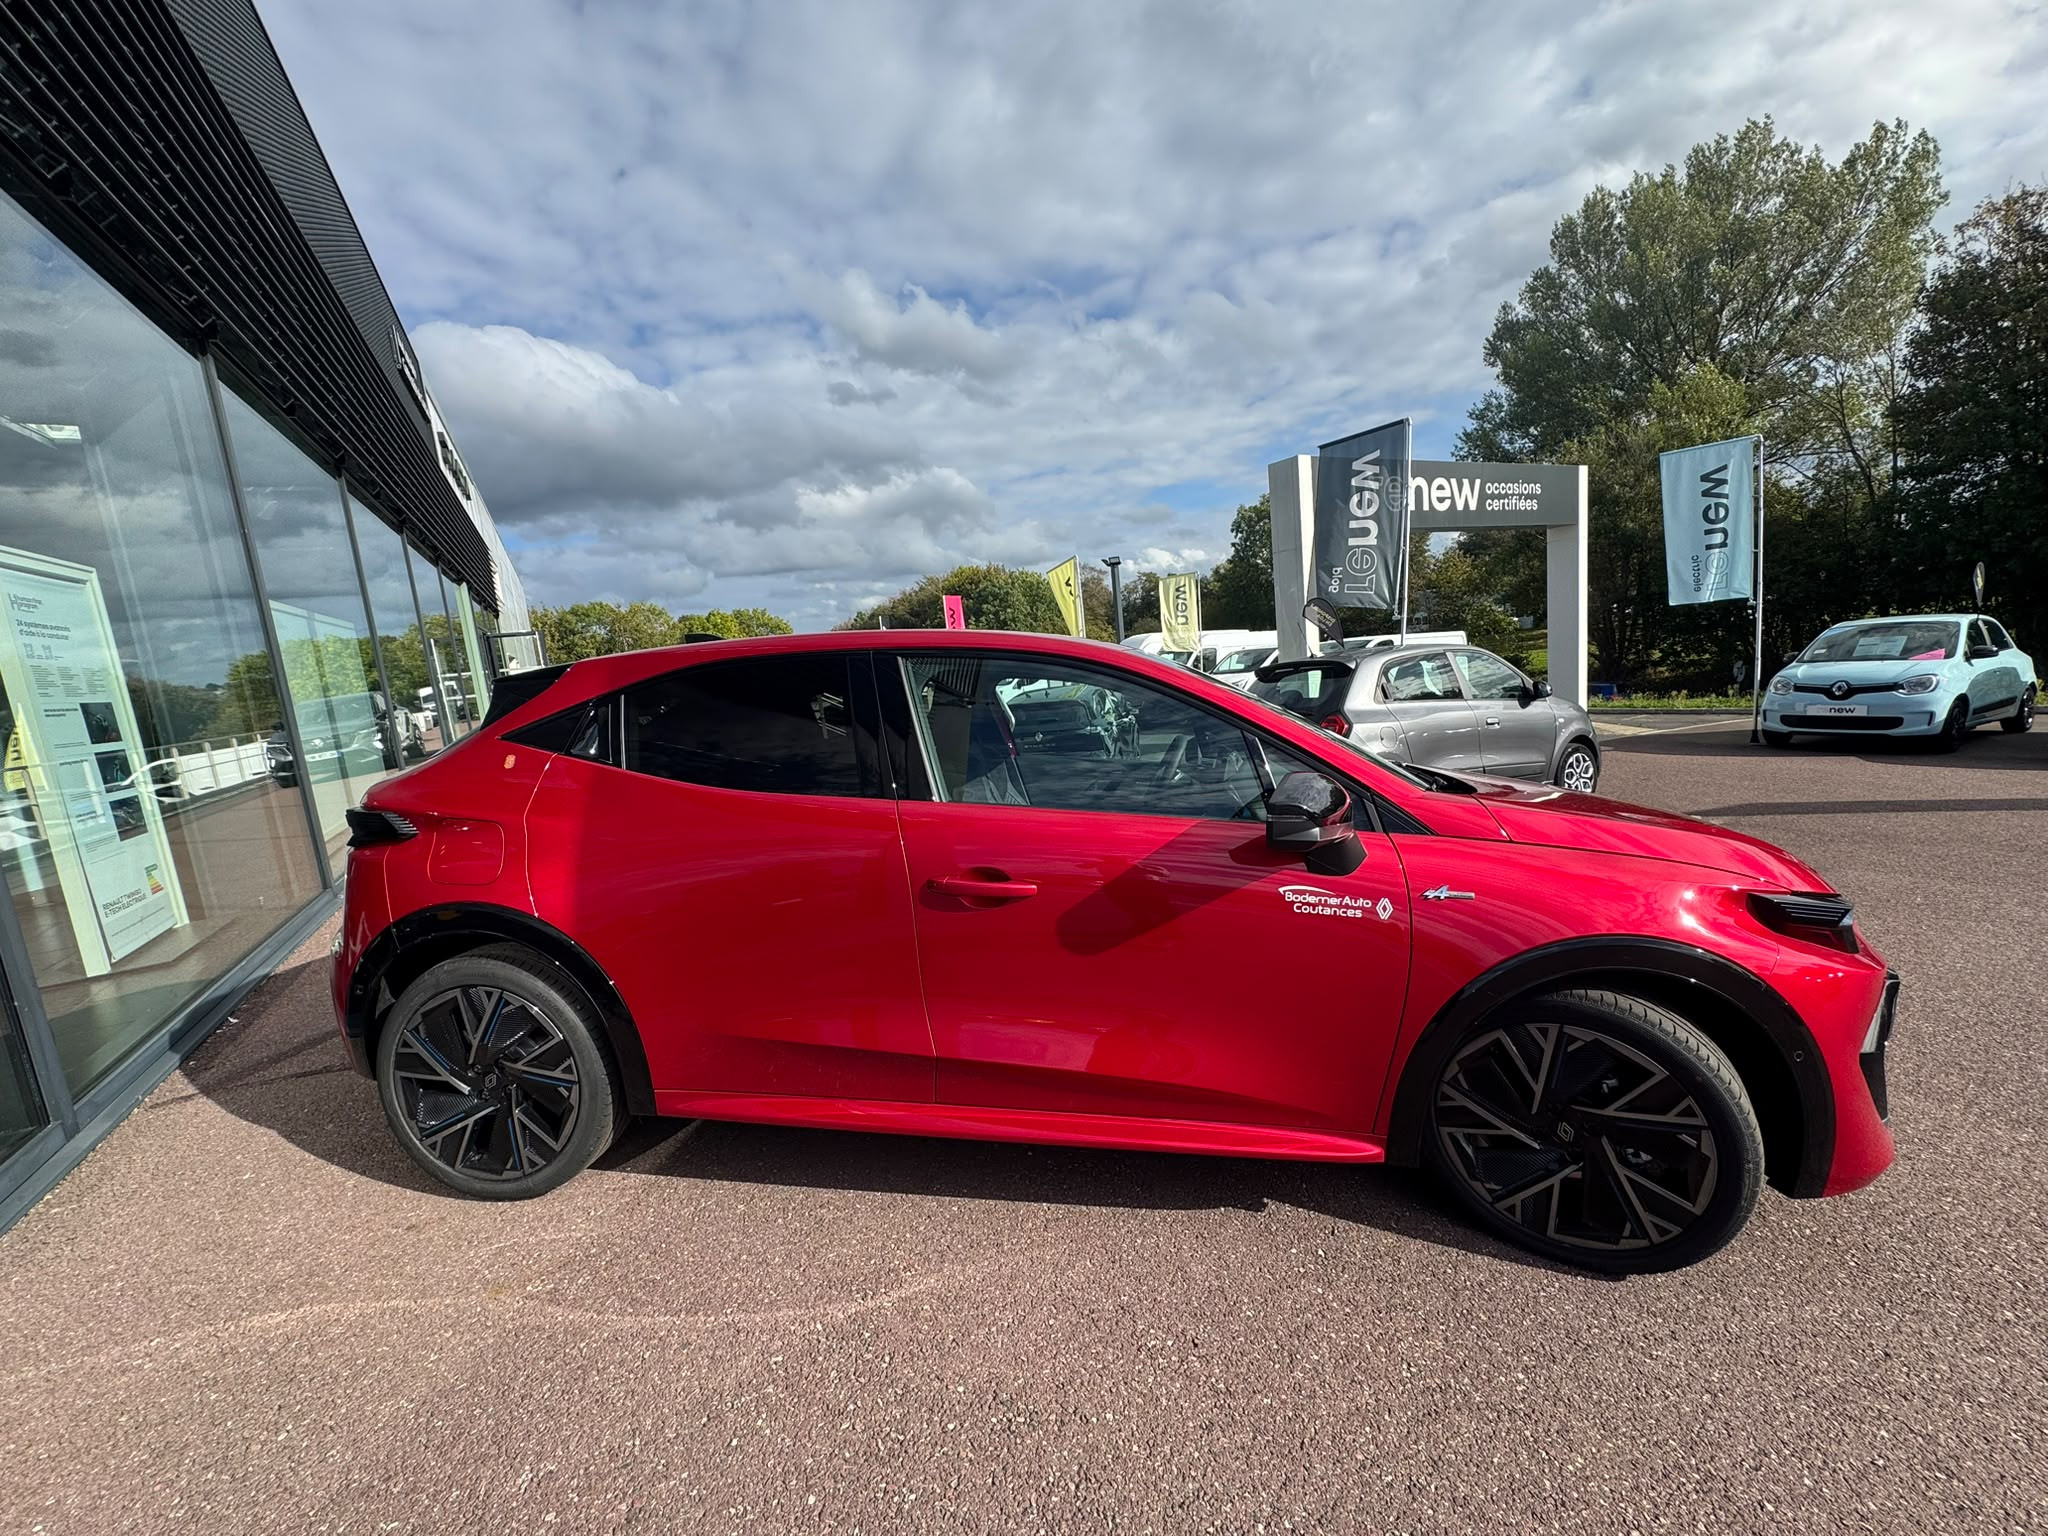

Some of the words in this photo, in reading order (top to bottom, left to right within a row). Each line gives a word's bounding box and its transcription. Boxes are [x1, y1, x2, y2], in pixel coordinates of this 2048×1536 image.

[1485, 480, 1542, 495] occasions
[1485, 495, 1538, 511] certifiées
[1293, 903, 1363, 918] Coutances
